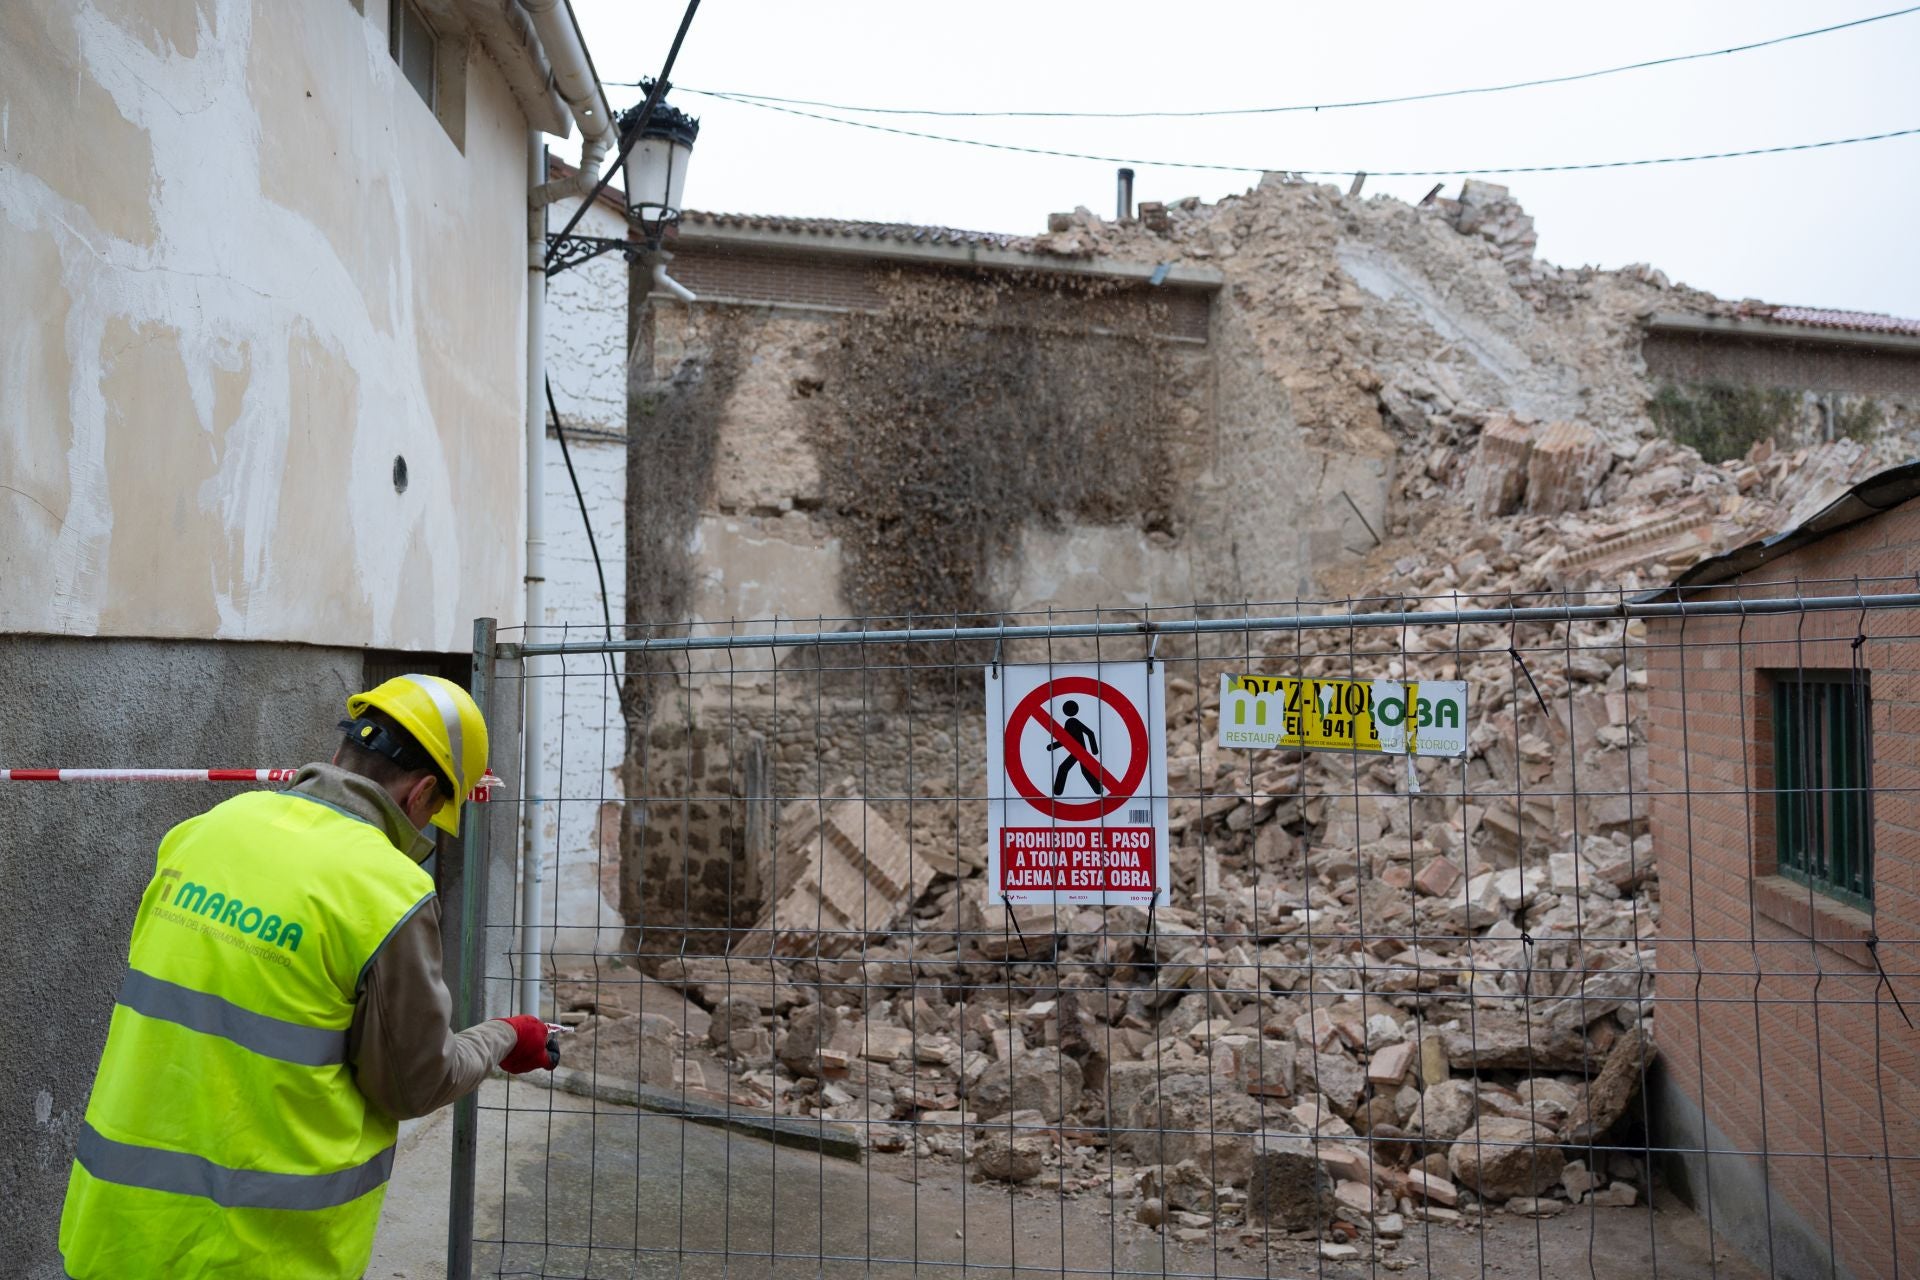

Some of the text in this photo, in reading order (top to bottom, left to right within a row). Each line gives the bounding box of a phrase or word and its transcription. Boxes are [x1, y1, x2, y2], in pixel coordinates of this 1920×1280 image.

[1323, 719, 1354, 738] 941
[1006, 832, 1086, 848] PROHIBIDO
[1112, 832, 1150, 848] PASO
[1016, 851, 1140, 867] A TODA PERSONA
[1006, 870, 1151, 887] AJENA A ESTA OBRA
[174, 882, 303, 952] MAROBA
